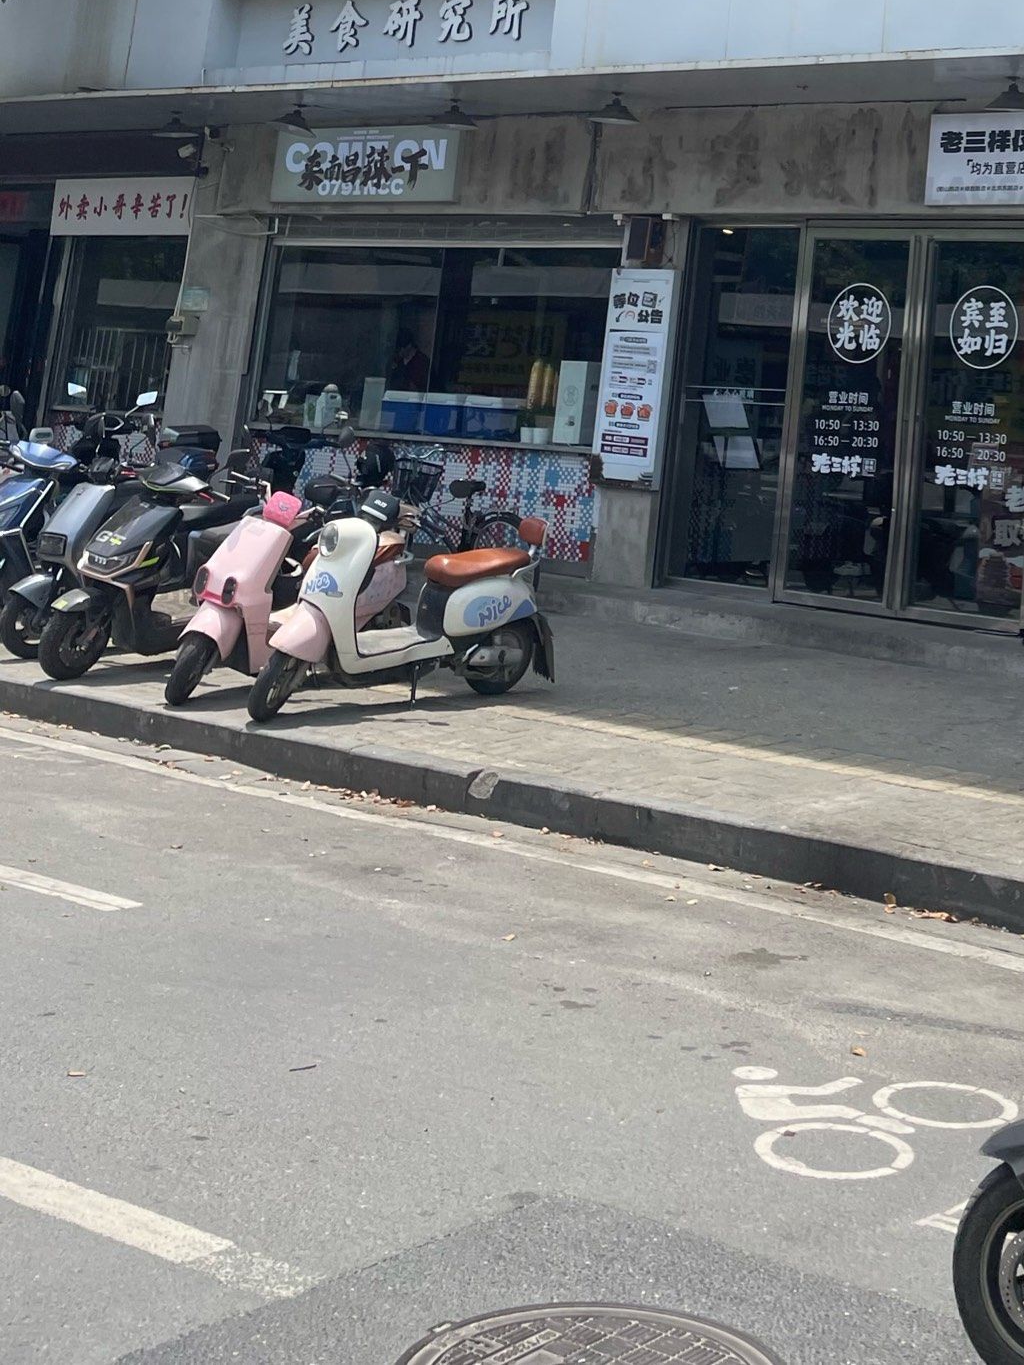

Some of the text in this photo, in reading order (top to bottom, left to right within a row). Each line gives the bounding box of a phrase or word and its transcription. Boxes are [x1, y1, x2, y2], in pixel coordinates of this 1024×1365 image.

[836, 295, 885, 323] 欢迎
[960, 298, 1009, 329] 宾至
[835, 322, 881, 352] 光临
[957, 328, 1009, 357] 如归
[828, 391, 869, 405] 营业时间
[952, 401, 995, 417] 营业时间
[478, 595, 512, 628] Nice
